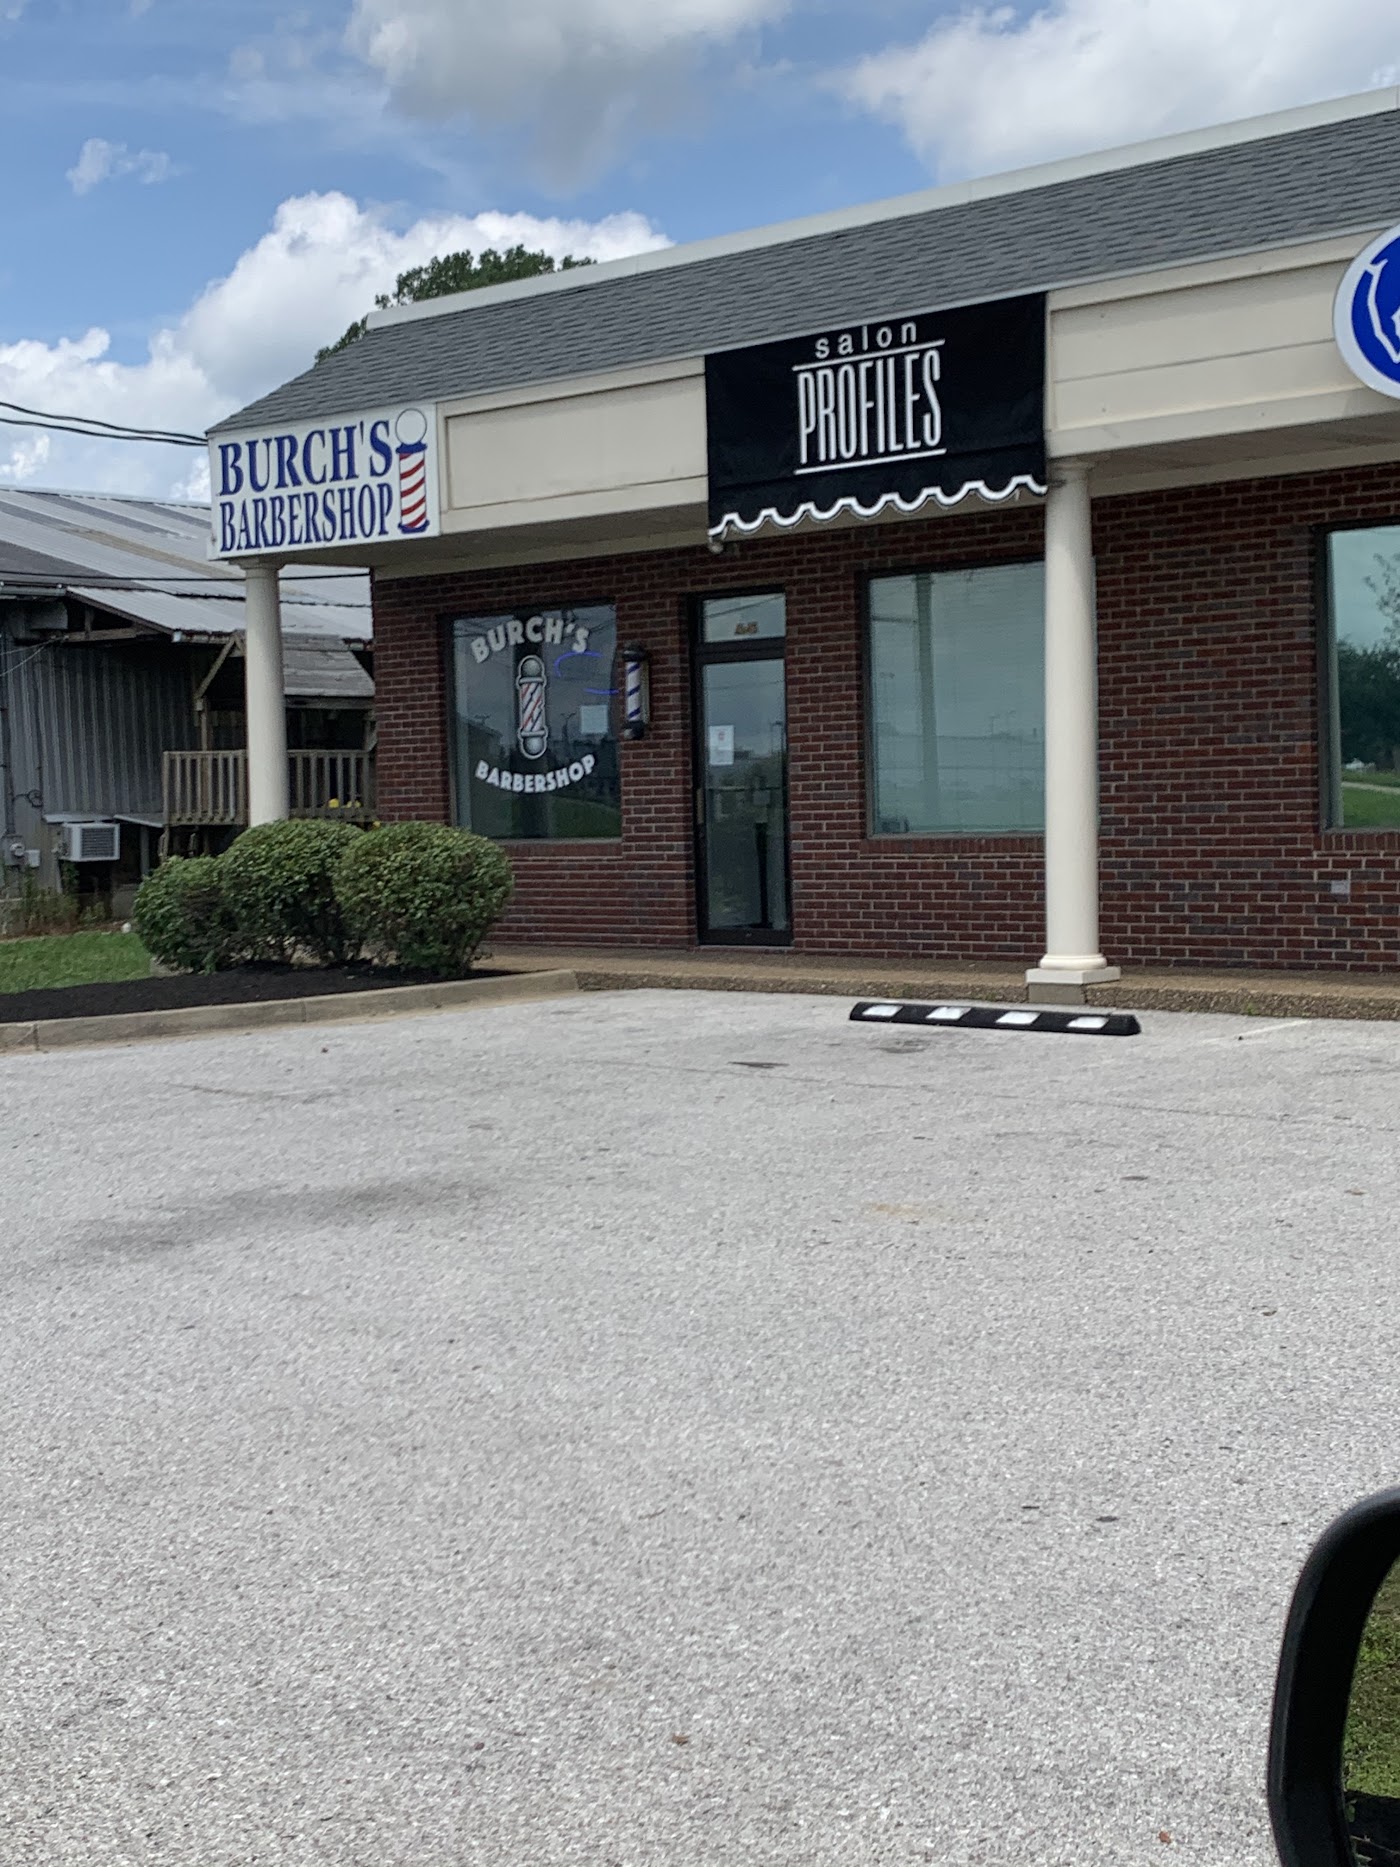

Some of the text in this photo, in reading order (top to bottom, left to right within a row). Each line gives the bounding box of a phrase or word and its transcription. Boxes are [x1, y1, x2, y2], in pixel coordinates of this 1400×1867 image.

[815, 322, 917, 359] salon
[799, 350, 942, 464] PROFILES
[218, 420, 392, 496] BURCH'S
[220, 483, 393, 552] BARBERSHOP
[471, 616, 589, 663] BURCH'S
[475, 754, 596, 793] BARBERSHOP
